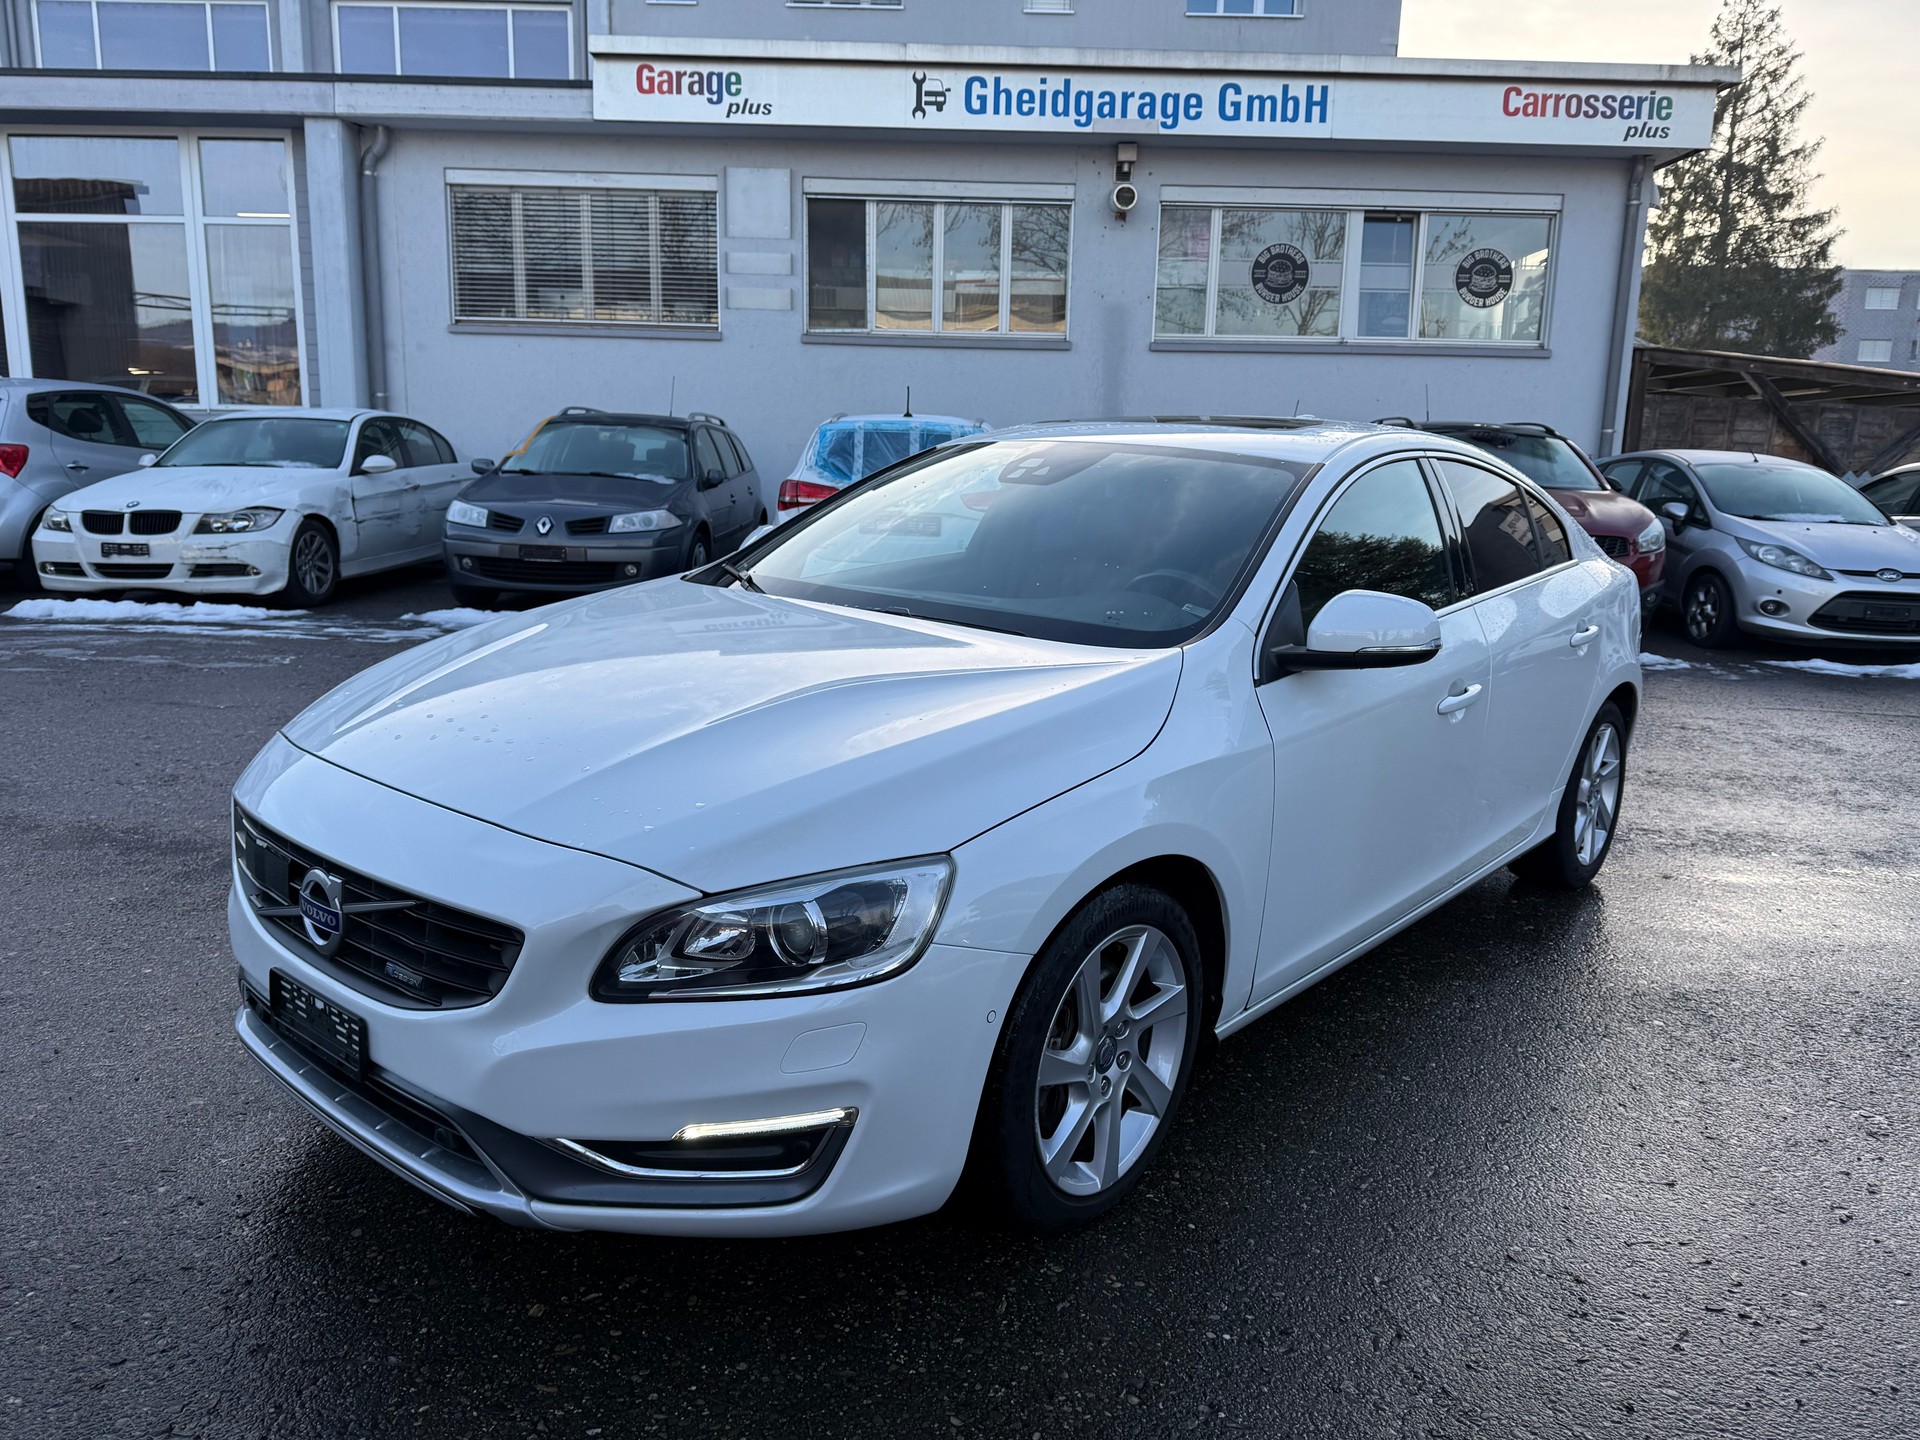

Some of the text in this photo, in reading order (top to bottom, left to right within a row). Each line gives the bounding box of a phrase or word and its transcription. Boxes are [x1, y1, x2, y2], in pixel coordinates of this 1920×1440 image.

[635, 63, 742, 105] Garage
[725, 98, 773, 118] plus
[964, 75, 1330, 130] Gheidgarage GmbH
[1502, 86, 1673, 121] Carrosserie
[1622, 121, 1671, 142] plus
[1257, 244, 1305, 265] BIG BROTHERS
[1461, 250, 1510, 270] BIG BROTHERS
[1255, 282, 1304, 303] BURGER HOUSE
[1459, 286, 1508, 307] BURGER HOUSE
[301, 899, 337, 927] VOLVO
